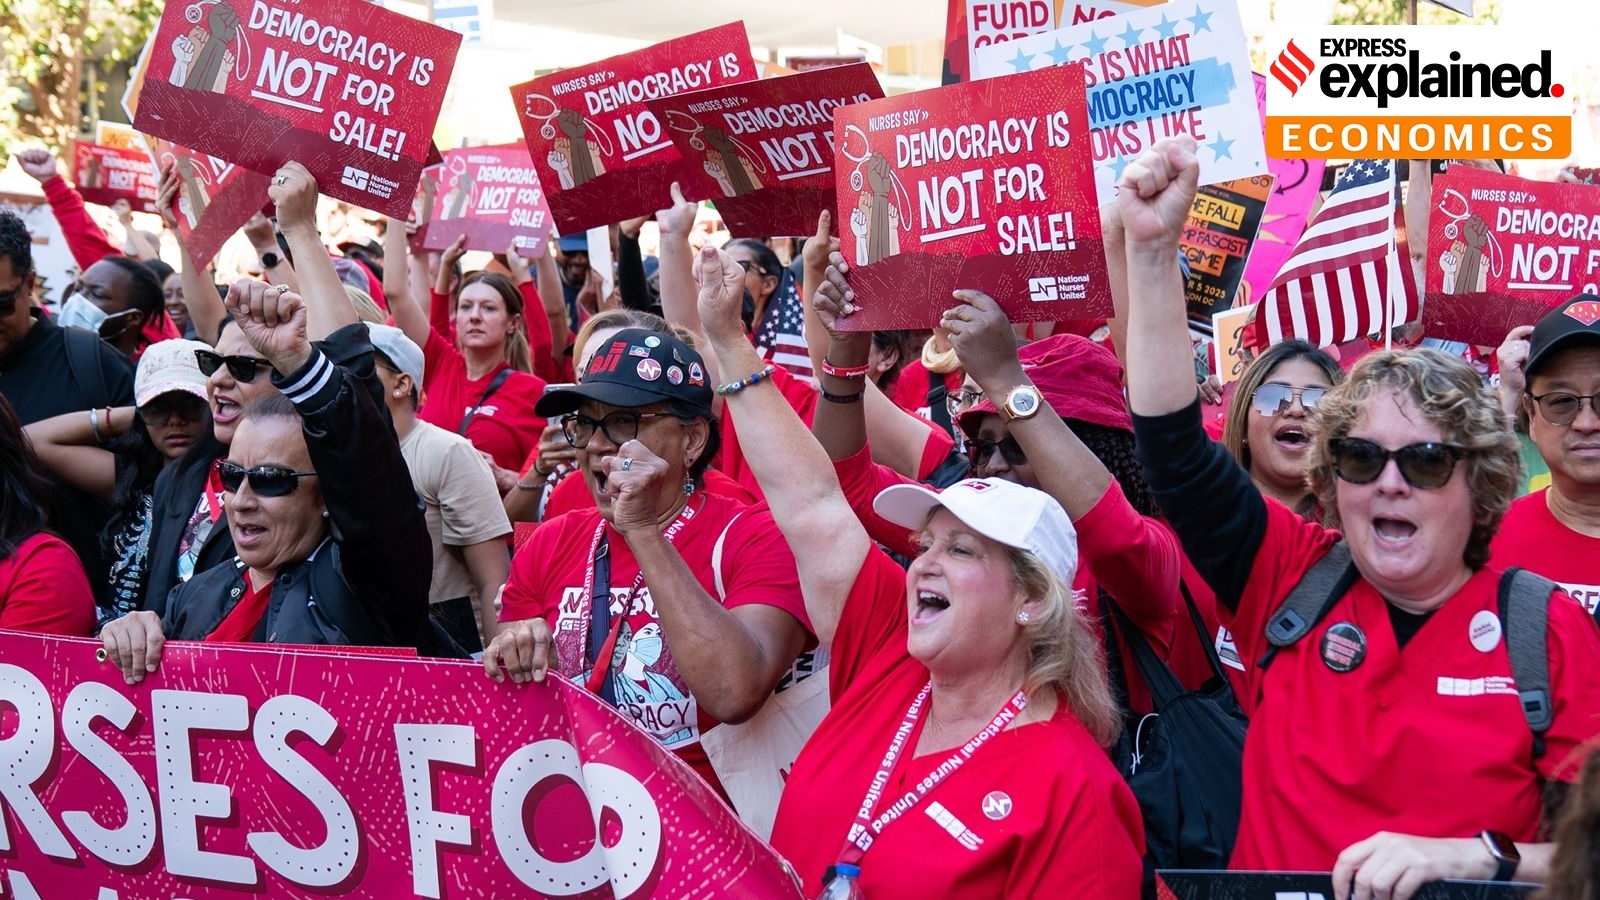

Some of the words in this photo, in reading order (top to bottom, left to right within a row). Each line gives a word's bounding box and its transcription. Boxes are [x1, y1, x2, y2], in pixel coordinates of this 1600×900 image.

[248, 1, 407, 75] DEMOCRACY
[407, 56, 435, 86] IS
[1101, 50, 1126, 85] IS
[1124, 33, 1192, 78] WHAT
[255, 47, 338, 104] NOT
[342, 73, 395, 116] FOR
[552, 77, 587, 97] NURSES
[589, 71, 608, 88] SAY
[584, 60, 714, 115] DEMOCRACY
[718, 52, 741, 79] IS
[687, 101, 722, 115] NURSES
[722, 97, 741, 111] SAY
[868, 113, 901, 133] NURSES
[902, 109, 921, 128] SAY
[329, 111, 407, 162] SALE!
[759, 131, 827, 174] NOT
[895, 116, 1038, 169] DEMOCRACY
[1046, 111, 1071, 148] IS
[108, 169, 138, 190] NOT
[367, 186, 390, 199] United
[369, 180, 392, 193] Nurses
[370, 174, 400, 189] National
[479, 186, 516, 210] NOT
[515, 189, 541, 206] FOR
[917, 168, 984, 231] NOT
[994, 163, 1047, 205] FOR
[1471, 188, 1506, 203] NURSES
[1508, 190, 1528, 204] SAY
[509, 208, 545, 229] SALE!
[1191, 217, 1208, 229] THE
[1206, 201, 1239, 225] FALL
[997, 211, 1077, 256] SALE!
[1196, 231, 1247, 255] FASCIST
[1057, 273, 1090, 284] National
[1510, 243, 1580, 282] NOT
[1058, 284, 1085, 292] Nurses
[1060, 291, 1086, 300] United
[1202, 295, 1215, 306] DC
[1205, 284, 1227, 299] 2025
[587, 518, 606, 567] National
[581, 567, 594, 608] Nurses
[579, 610, 590, 653] United
[884, 719, 914, 768] Nurses
[960, 707, 1015, 759] National
[916, 753, 964, 795] Nurses
[858, 769, 889, 821] United
[871, 791, 919, 834] United
